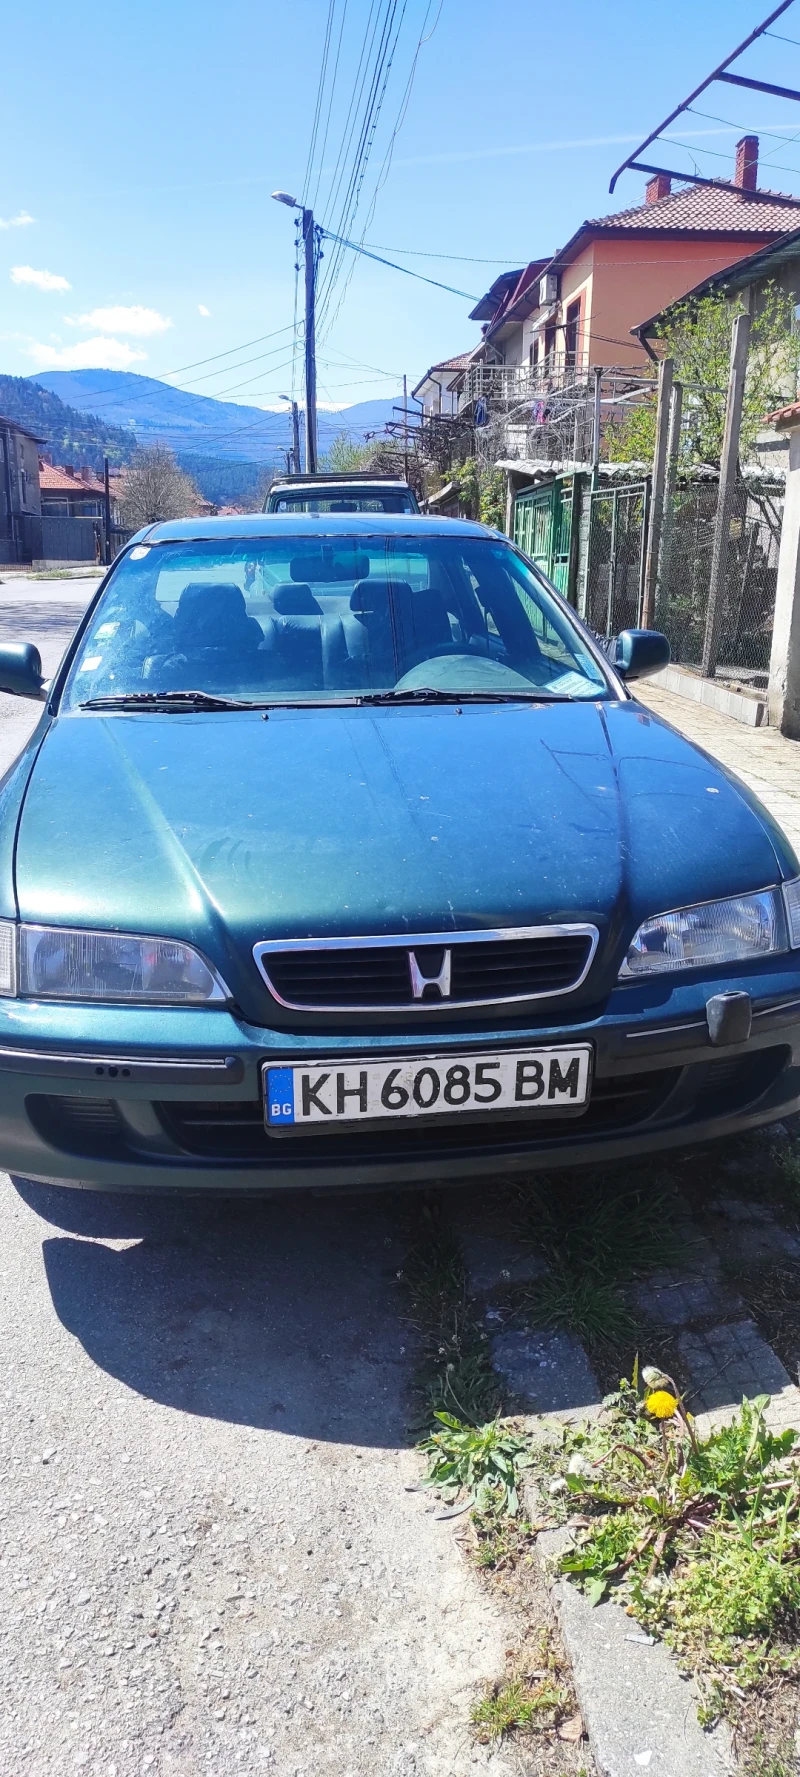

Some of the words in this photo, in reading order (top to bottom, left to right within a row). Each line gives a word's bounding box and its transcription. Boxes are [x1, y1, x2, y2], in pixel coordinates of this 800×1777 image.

[407, 949, 452, 998] H
[271, 1103, 292, 1117] BG
[301, 1071, 368, 1117] KH
[380, 1061, 503, 1110] 6085
[514, 1057, 581, 1101] BM
